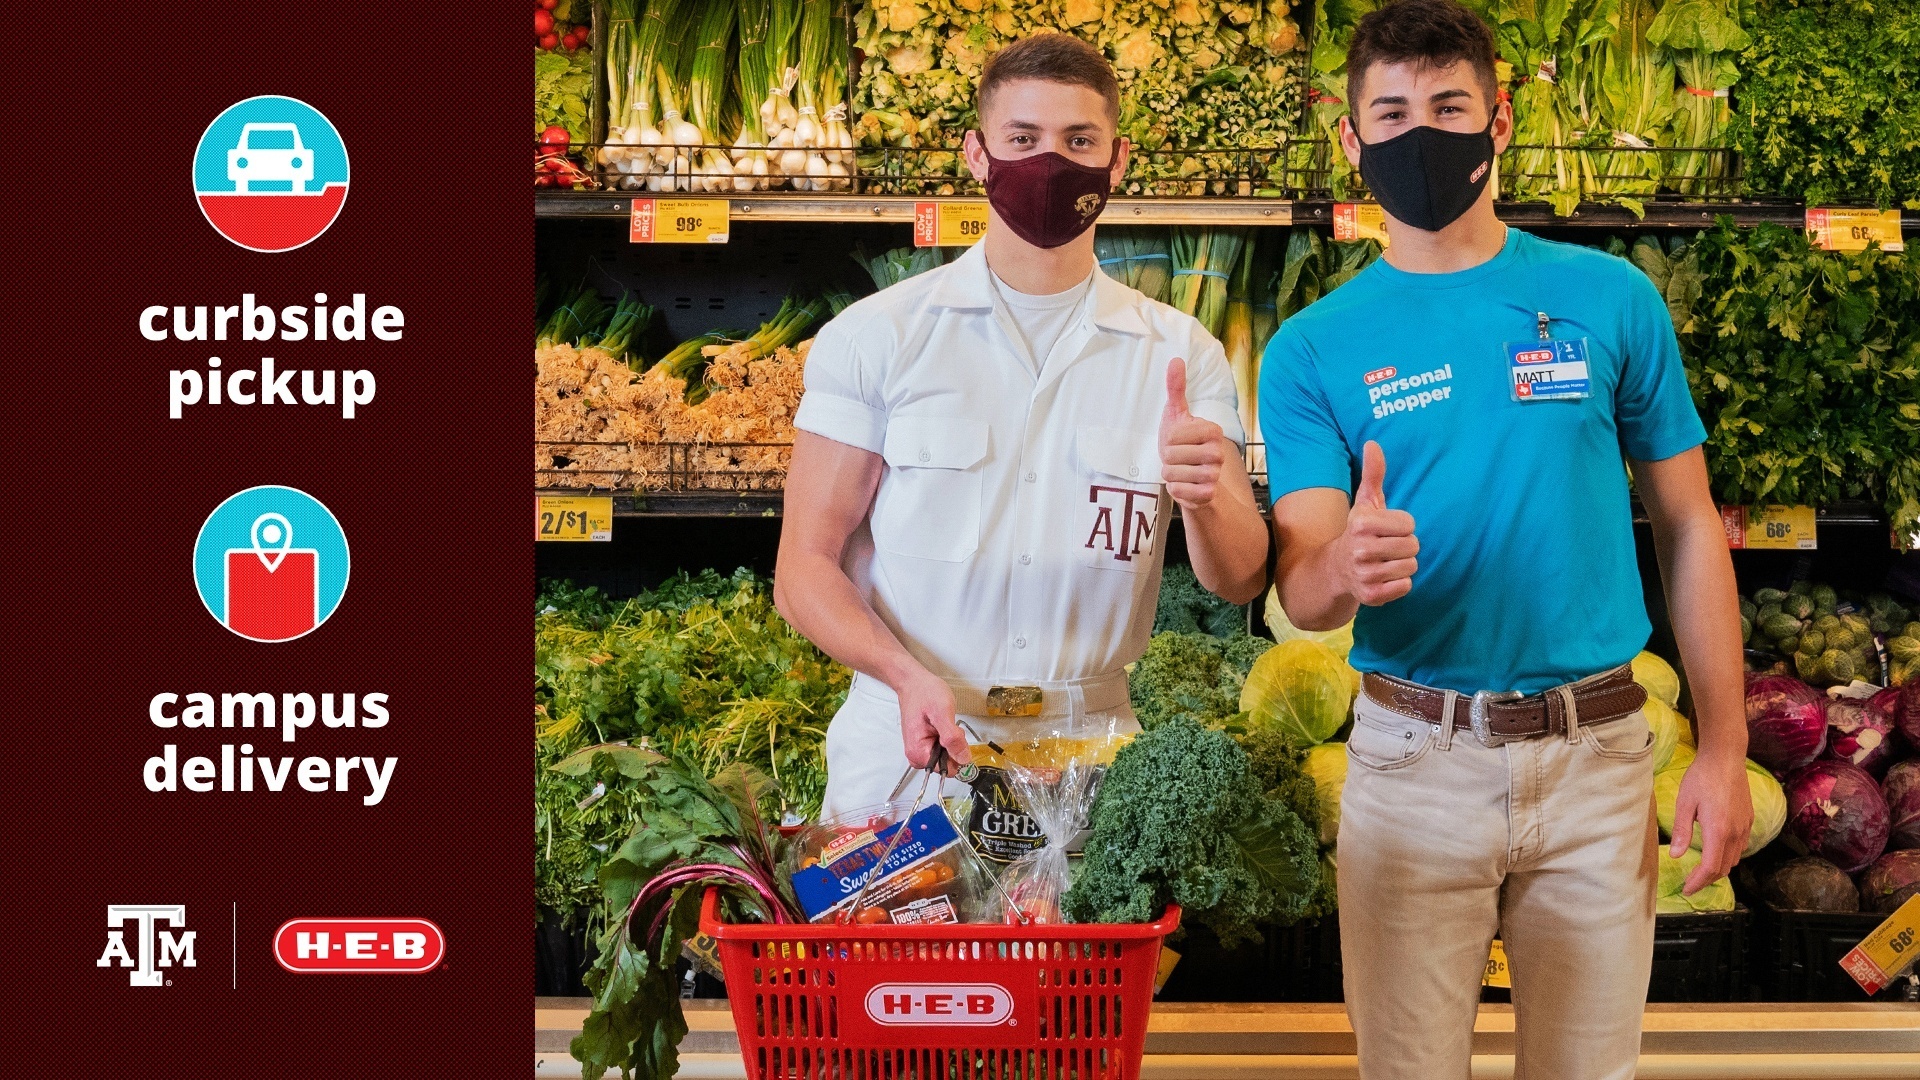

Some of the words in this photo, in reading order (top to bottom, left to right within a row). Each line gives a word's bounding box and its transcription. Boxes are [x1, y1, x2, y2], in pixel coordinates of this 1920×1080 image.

[633, 209, 643, 232] LOW
[641, 203, 651, 238] PRICES
[917, 213, 926, 236] LOW
[925, 207, 934, 242] PRICES
[960, 220, 987, 235] 98¢
[1335, 214, 1345, 236] LOW
[1851, 226, 1875, 240] 68
[1520, 352, 1550, 362] H-E-B
[1565, 343, 1574, 353] 1
[1368, 363, 1453, 405] personal
[1516, 369, 1555, 384] MATT
[1373, 385, 1452, 420] shopper
[541, 510, 588, 535] 2/$1
[1725, 516, 1733, 539] LOW
[1732, 509, 1741, 545] PRICES
[1766, 522, 1792, 538] 68¢
[982, 811, 1046, 838] GRE
[826, 847, 845, 861] Select
[884, 852, 900, 865] BITE
[900, 841, 922, 855] SIZED
[988, 838, 1007, 847] Triple
[1008, 840, 1032, 849] Washed
[828, 852, 868, 881] TEXAS
[887, 846, 926, 869] TOMATO
[895, 909, 921, 924] 100%
[1863, 940, 1873, 948] Red
[1873, 920, 1895, 939] Cabbage
[1487, 959, 1505, 975] 8¢
[1849, 965, 1871, 986] LOW
[1851, 953, 1882, 984] PRICES
[883, 994, 995, 1015] H-E-B
